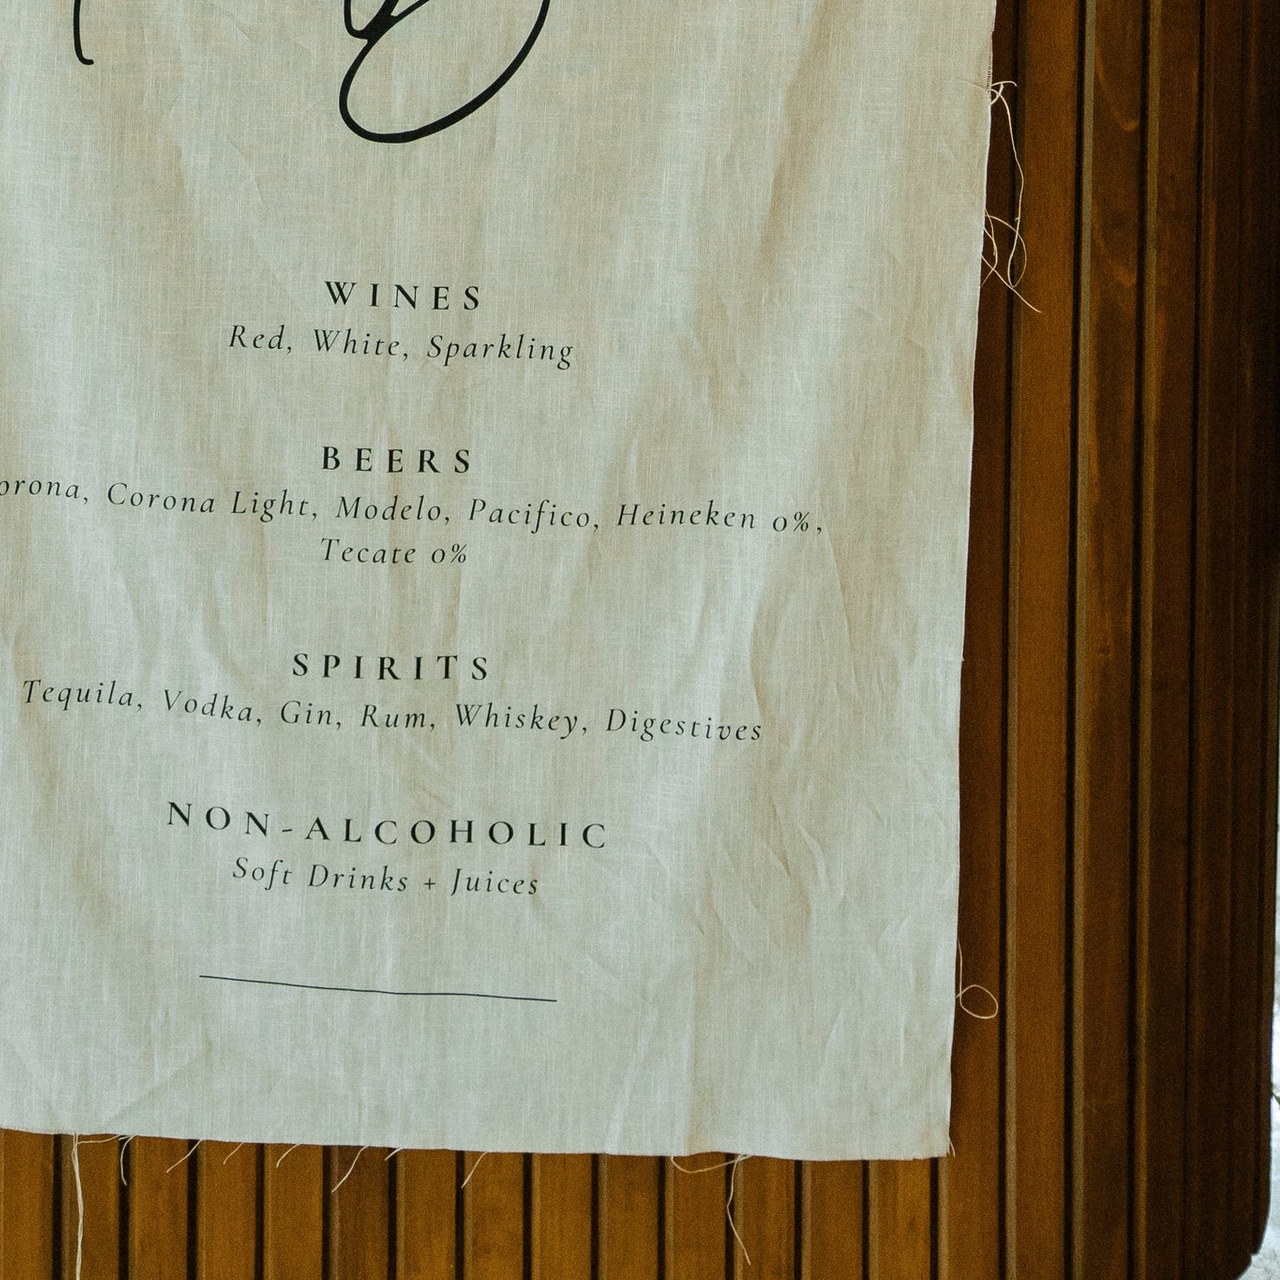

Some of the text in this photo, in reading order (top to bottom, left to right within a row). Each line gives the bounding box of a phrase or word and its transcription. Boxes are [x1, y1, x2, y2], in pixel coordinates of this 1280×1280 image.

[324, 280, 480, 311] WINES
[229, 323, 574, 371] Red, White, Sparkling
[322, 446, 470, 474] BEERS
[107, 482, 215, 514] Corona
[231, 488, 318, 524] Light,
[335, 494, 450, 525] Modelo,
[469, 498, 599, 535] Pacifico,
[616, 499, 757, 532] Heineken
[321, 537, 417, 565] Tecate
[292, 653, 487, 681] SPIRITS
[22, 678, 762, 742] Tequila, Vodka, Gin, Rum, Whiskey, Digestives
[167, 801, 605, 849] NON-ALCOHOLIC
[232, 857, 539, 897] Soft Drinks + Juices
